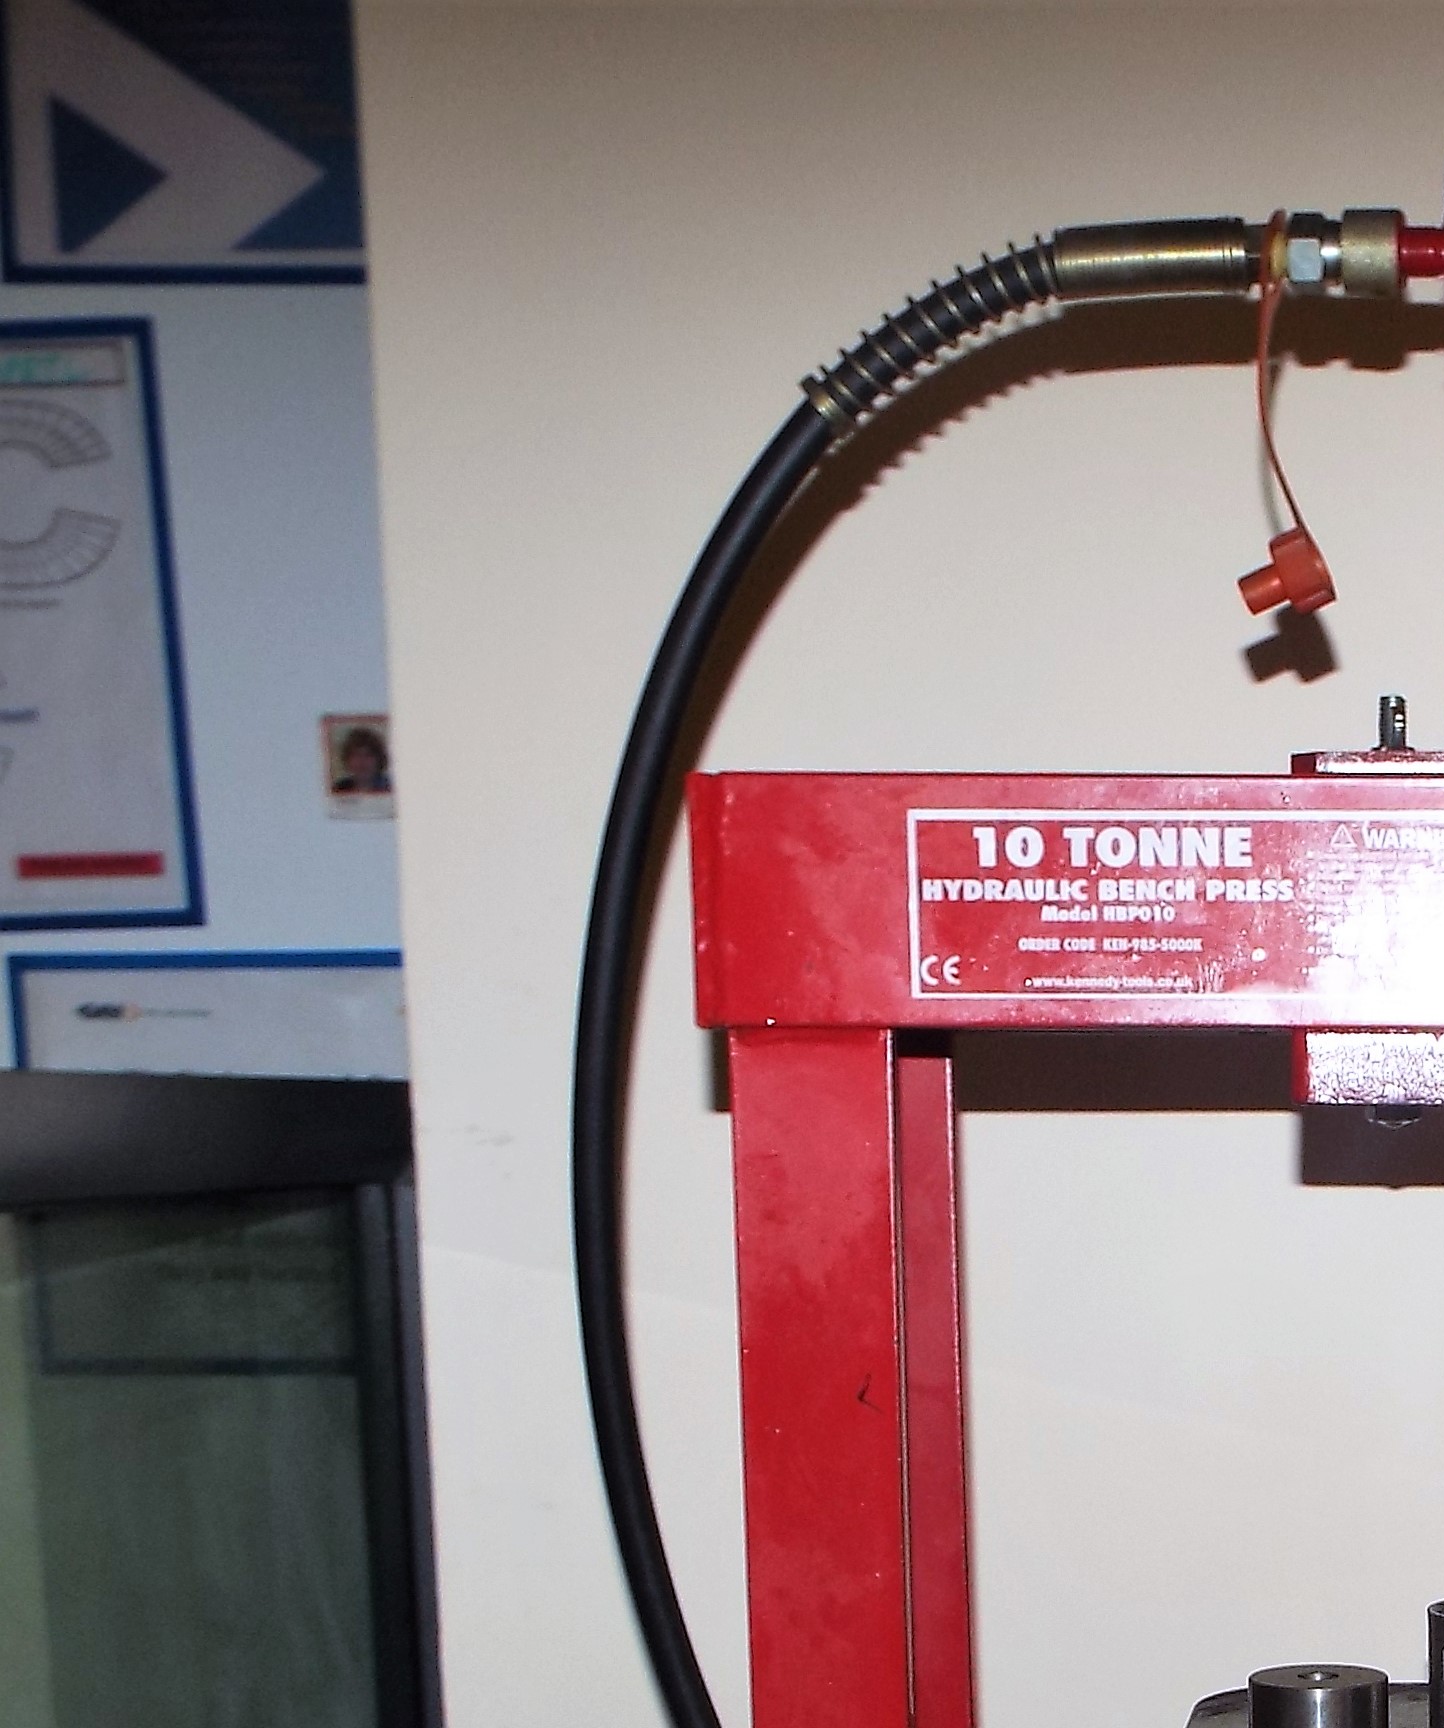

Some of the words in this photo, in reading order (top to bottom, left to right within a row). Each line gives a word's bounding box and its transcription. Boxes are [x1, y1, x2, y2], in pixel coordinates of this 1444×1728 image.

[972, 826, 1045, 868] 10
[1063, 826, 1254, 868] TONNE
[922, 878, 1089, 903] HYDRAULIC
[1098, 878, 1196, 903] BENCH
[1205, 878, 1295, 903] PRESS
[1041, 905, 1098, 922] Model
[1103, 905, 1176, 922] HBP010
[1018, 937, 1061, 952] ORDER
[1063, 937, 1096, 952] CODE
